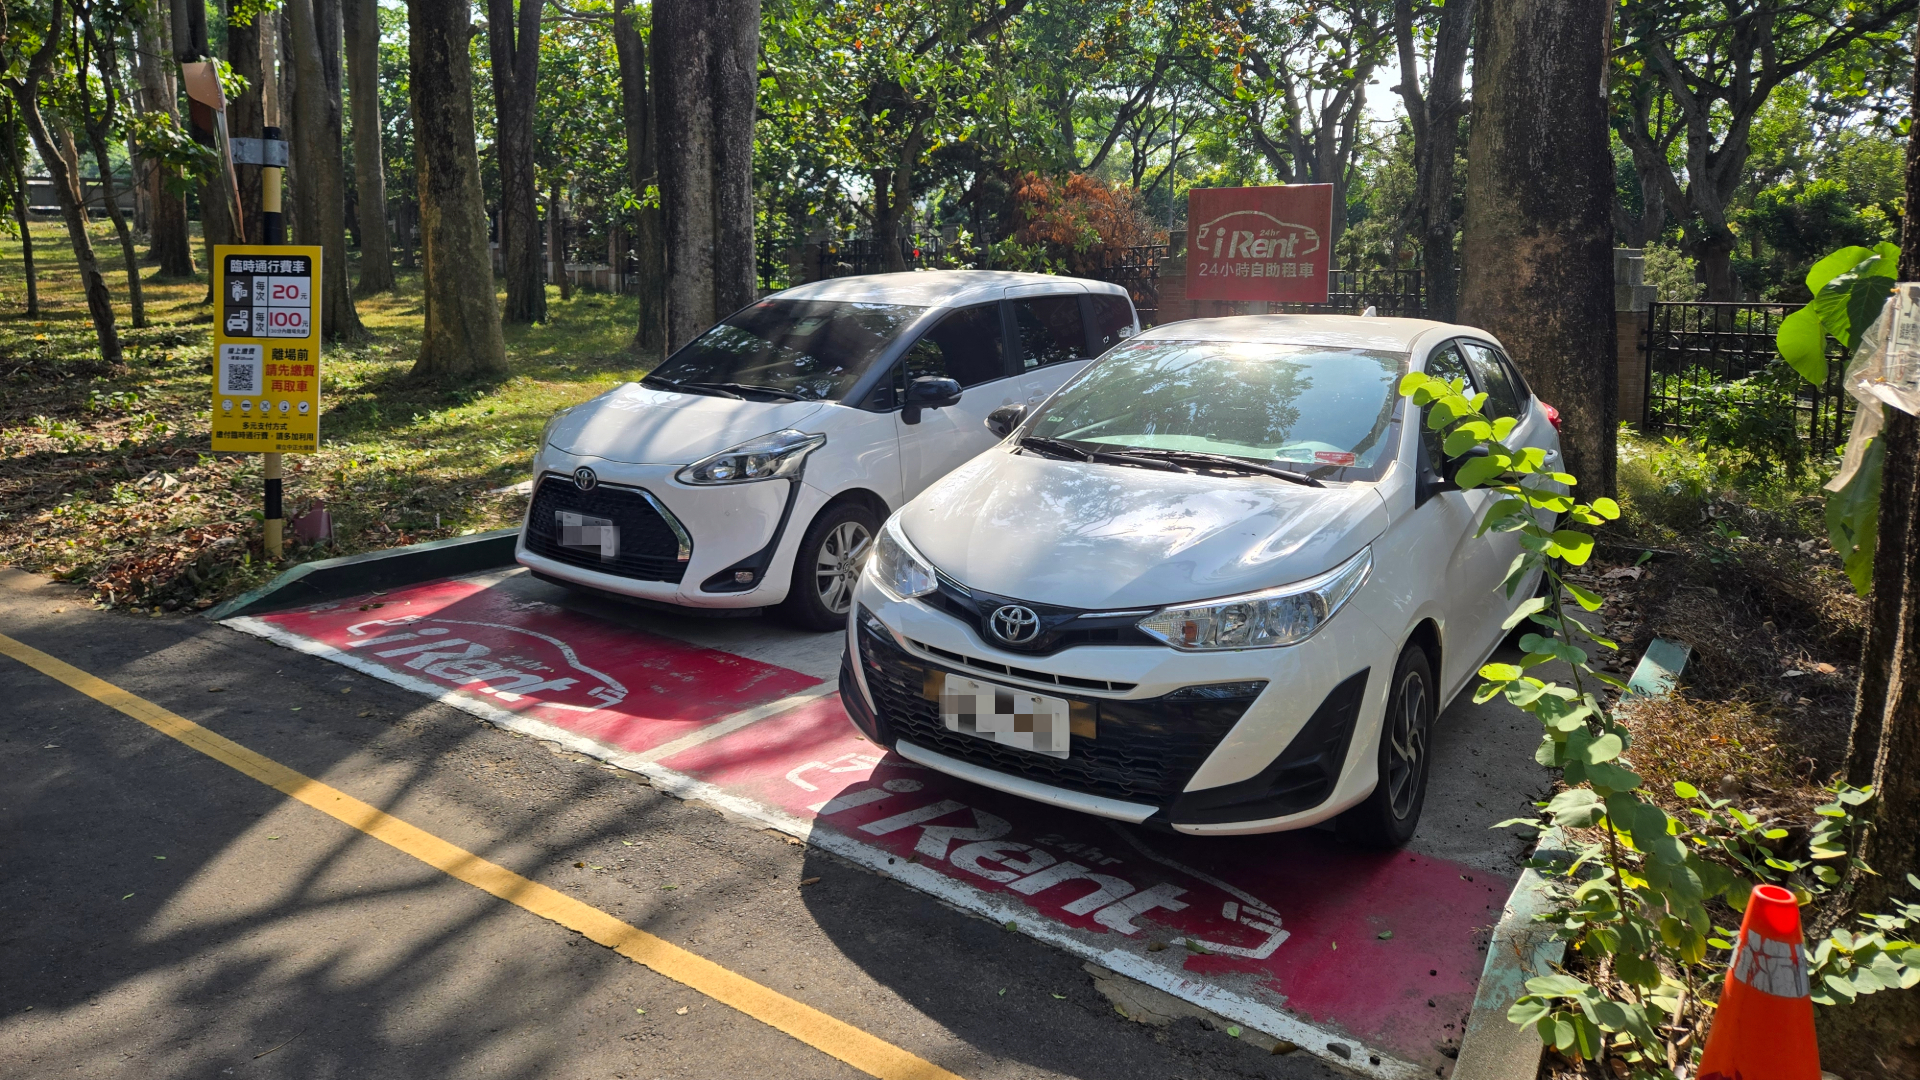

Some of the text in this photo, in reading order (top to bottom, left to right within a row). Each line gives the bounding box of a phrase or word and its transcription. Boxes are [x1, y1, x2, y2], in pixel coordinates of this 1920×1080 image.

[1259, 229, 1280, 237] 24hr
[1213, 227, 1299, 258] iRent
[230, 259, 305, 273] 臨時通行費率
[1199, 262, 1315, 278] 24小時自助租車
[255, 281, 265, 301] 每次
[255, 312, 265, 332] 每次
[271, 348, 309, 361] 離場前
[265, 363, 315, 377] 請先繳費
[271, 380, 308, 393] 再取車
[242, 422, 288, 431] 多元支付方式
[346, 627, 580, 702] iRent
[806, 778, 1189, 935] iRent
